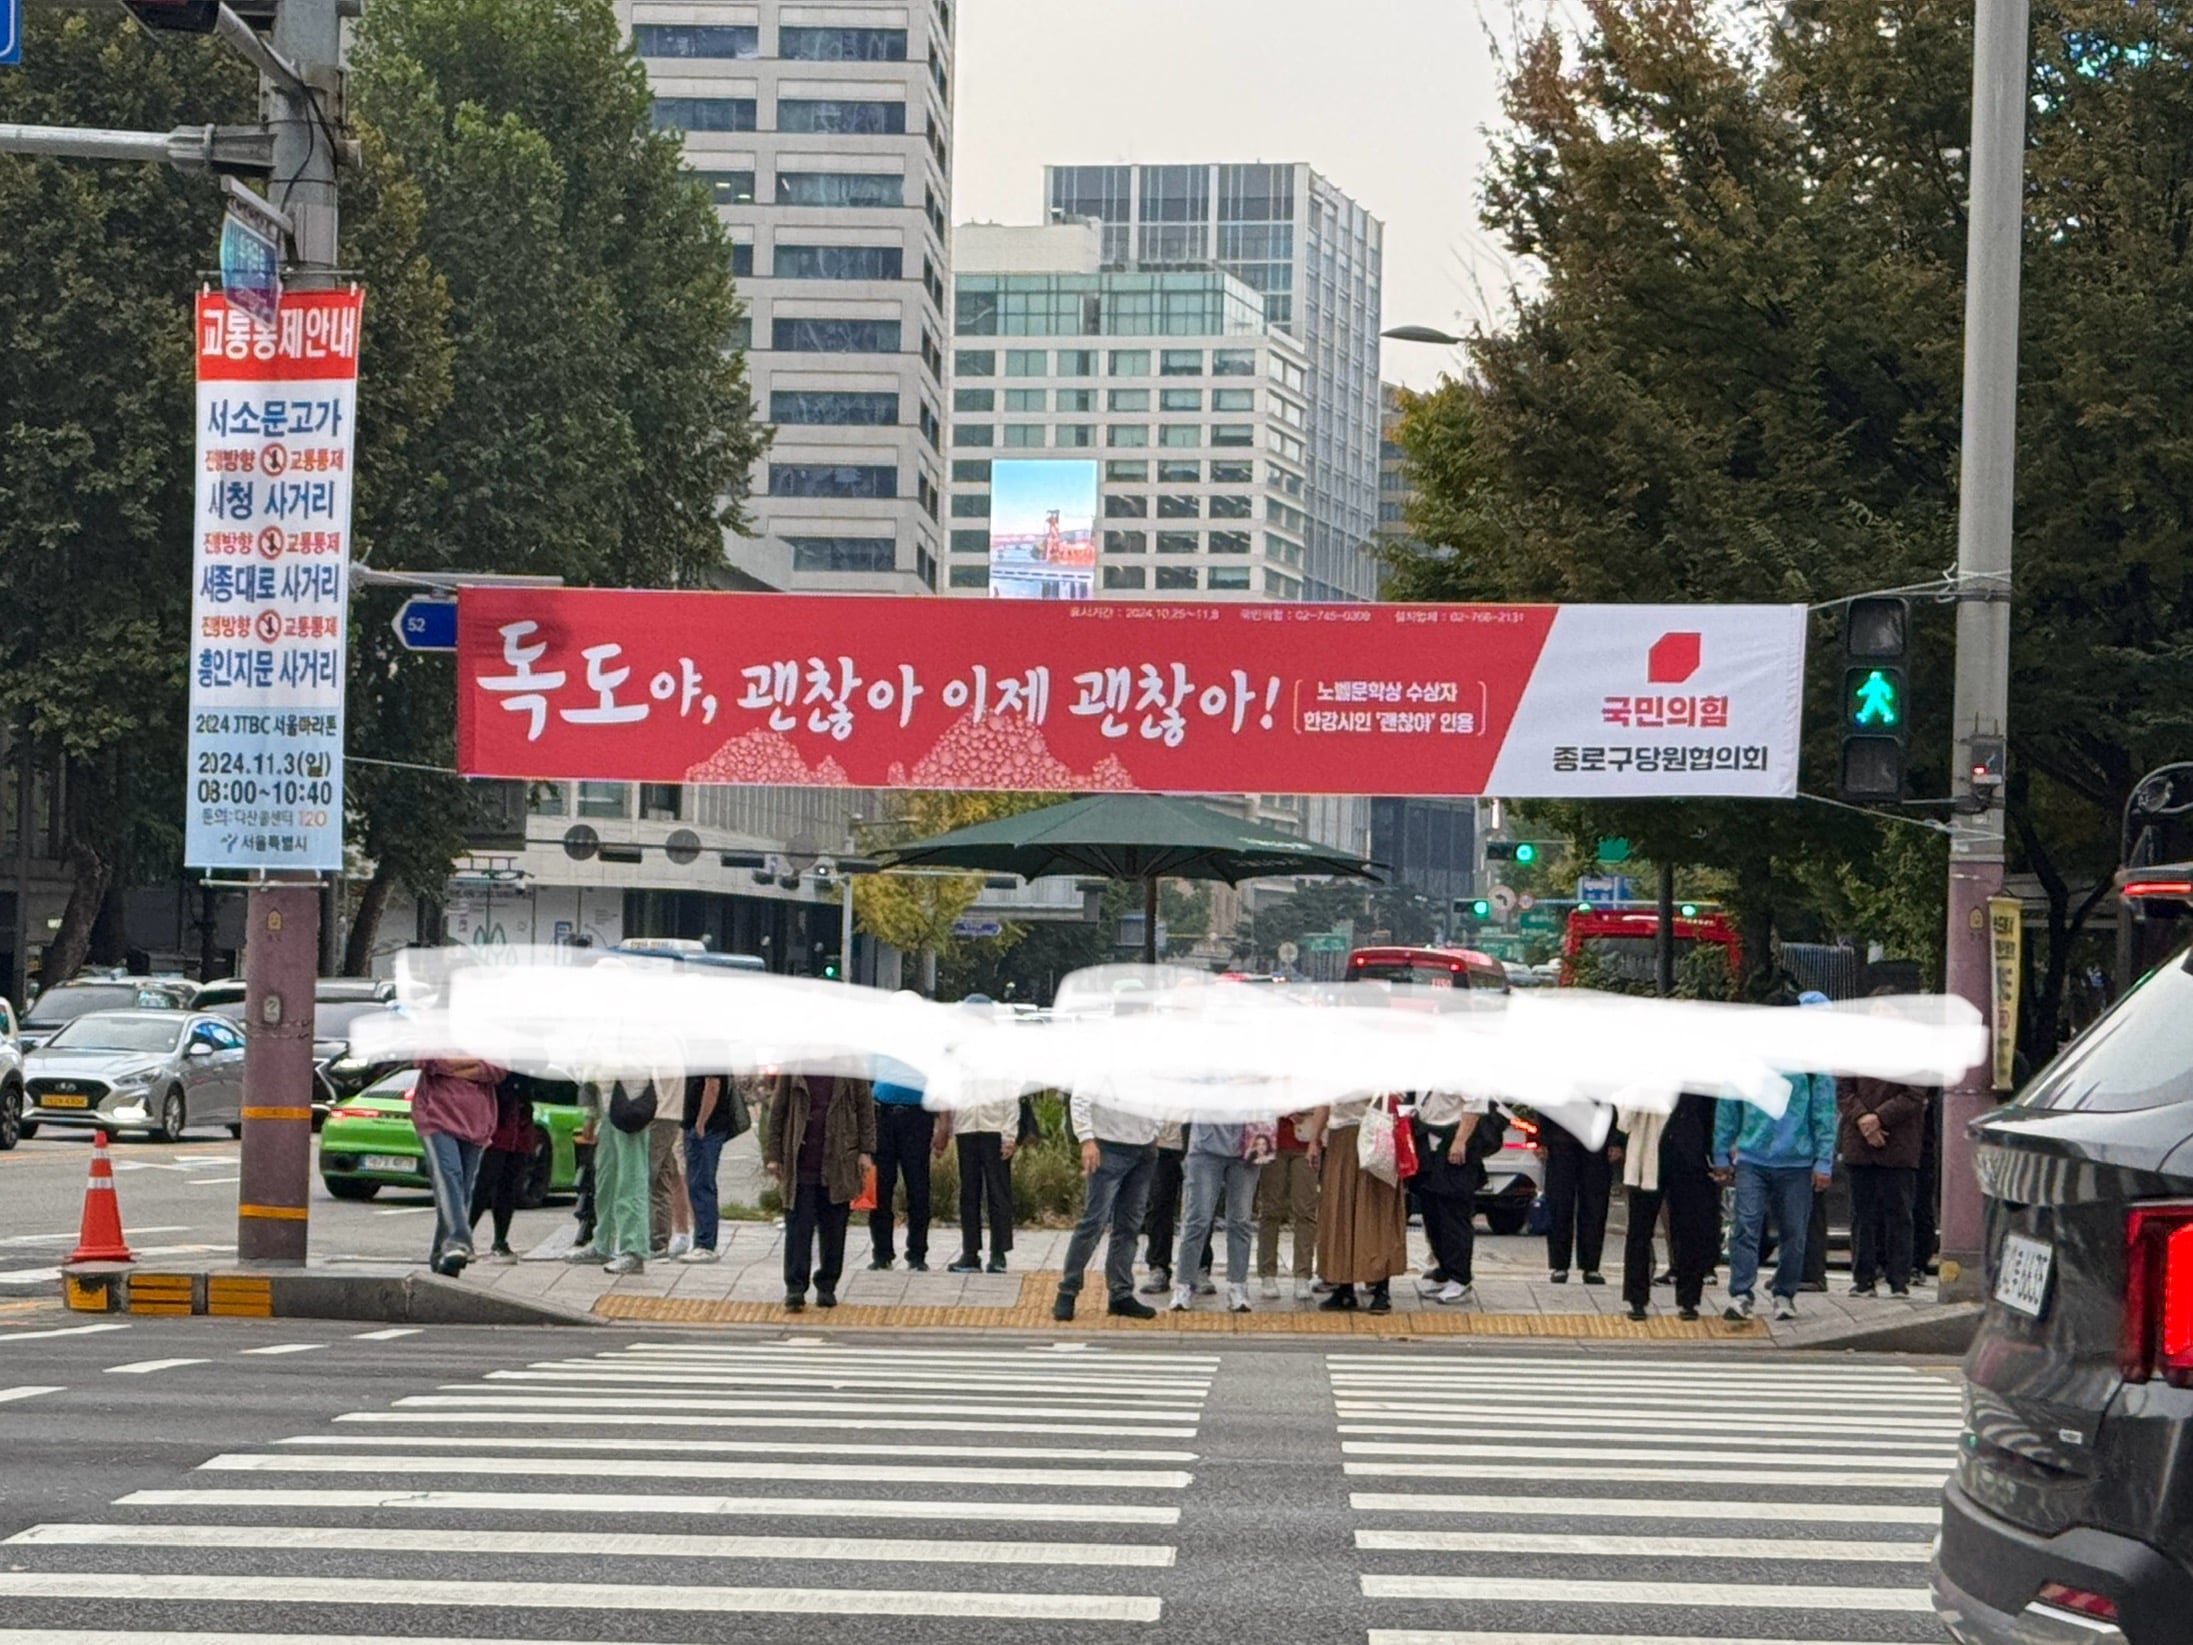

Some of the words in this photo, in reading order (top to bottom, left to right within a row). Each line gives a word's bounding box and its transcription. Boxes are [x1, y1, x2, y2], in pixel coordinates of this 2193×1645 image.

[208, 398, 342, 437] 서소문고가
[208, 479, 254, 520] 시청
[264, 480, 335, 520] 사거리
[281, 563, 340, 603] 사거리
[407, 616, 426, 633] 52
[197, 648, 274, 689] 흥인지문
[279, 649, 338, 689] 사거리
[475, 620, 718, 741] 독도야,
[737, 656, 924, 741] 괜찮아
[942, 664, 1050, 725] 이제
[1069, 662, 1281, 748] 괜찮아!
[1317, 680, 1402, 702] 노벨문학상
[1406, 681, 1459, 703] 수상자
[1304, 711, 1372, 733] 한강시인
[1440, 711, 1475, 734] 인용
[1601, 695, 1729, 728] 국민의힘
[233, 715, 271, 735] JTBC
[274, 714, 337, 737] 서울마라톤
[198, 751, 332, 778] 2024.11.3(일)
[1553, 745, 1768, 772] 종로구당원협의회
[297, 810, 328, 828] 120
[241, 834, 308, 852] 서울특별시
